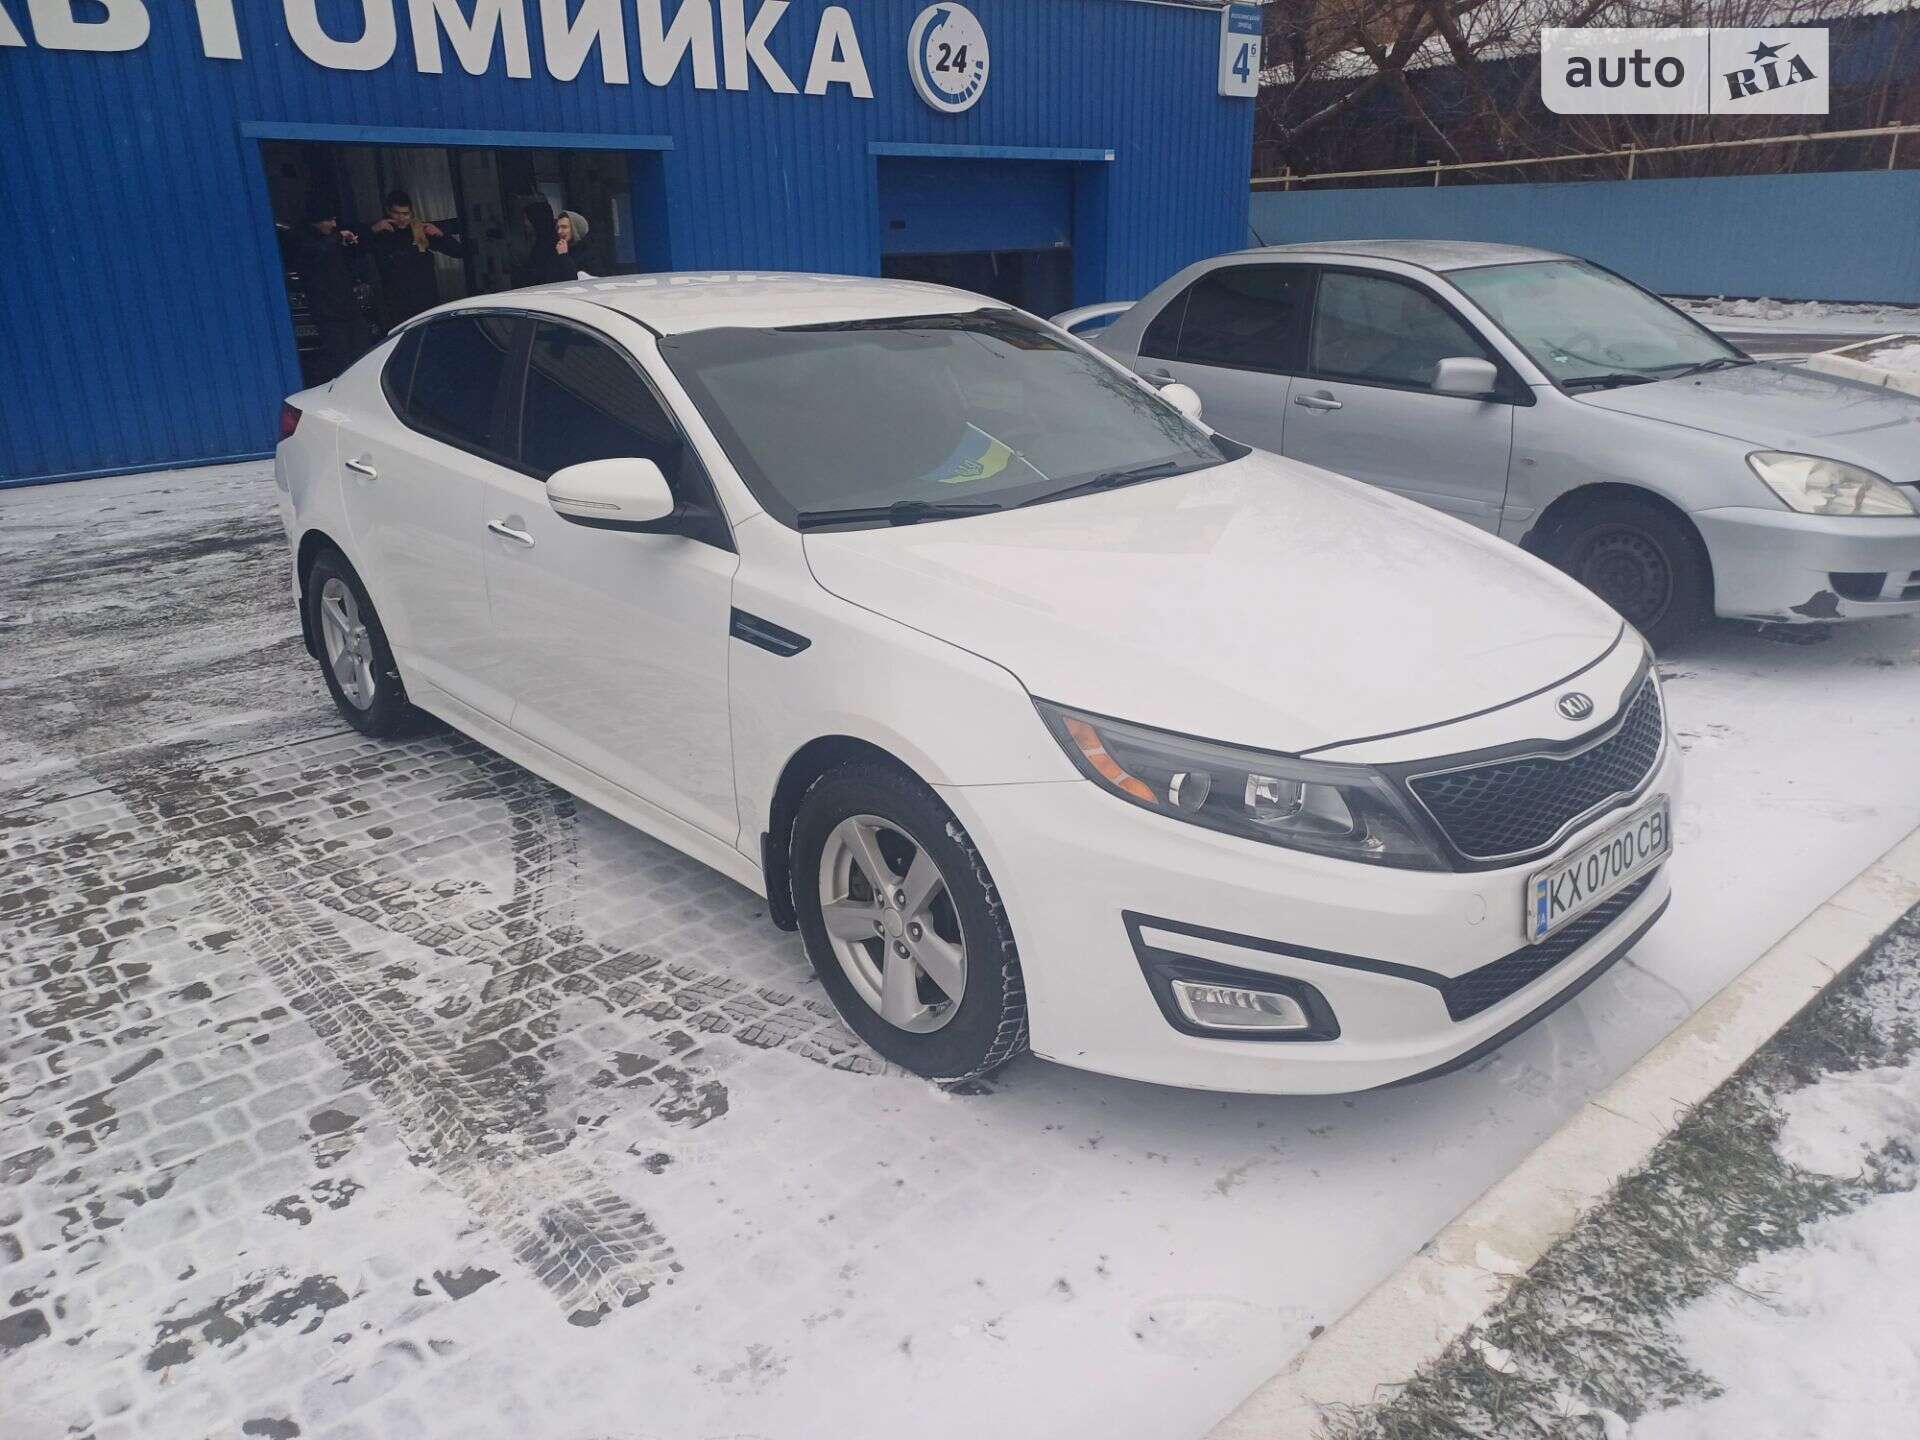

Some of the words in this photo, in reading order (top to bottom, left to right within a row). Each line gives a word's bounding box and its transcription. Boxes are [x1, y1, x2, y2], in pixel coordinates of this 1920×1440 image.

[935, 42, 968, 73] 24
[1550, 861, 1583, 919] KX
[1586, 831, 1634, 887] 0700
